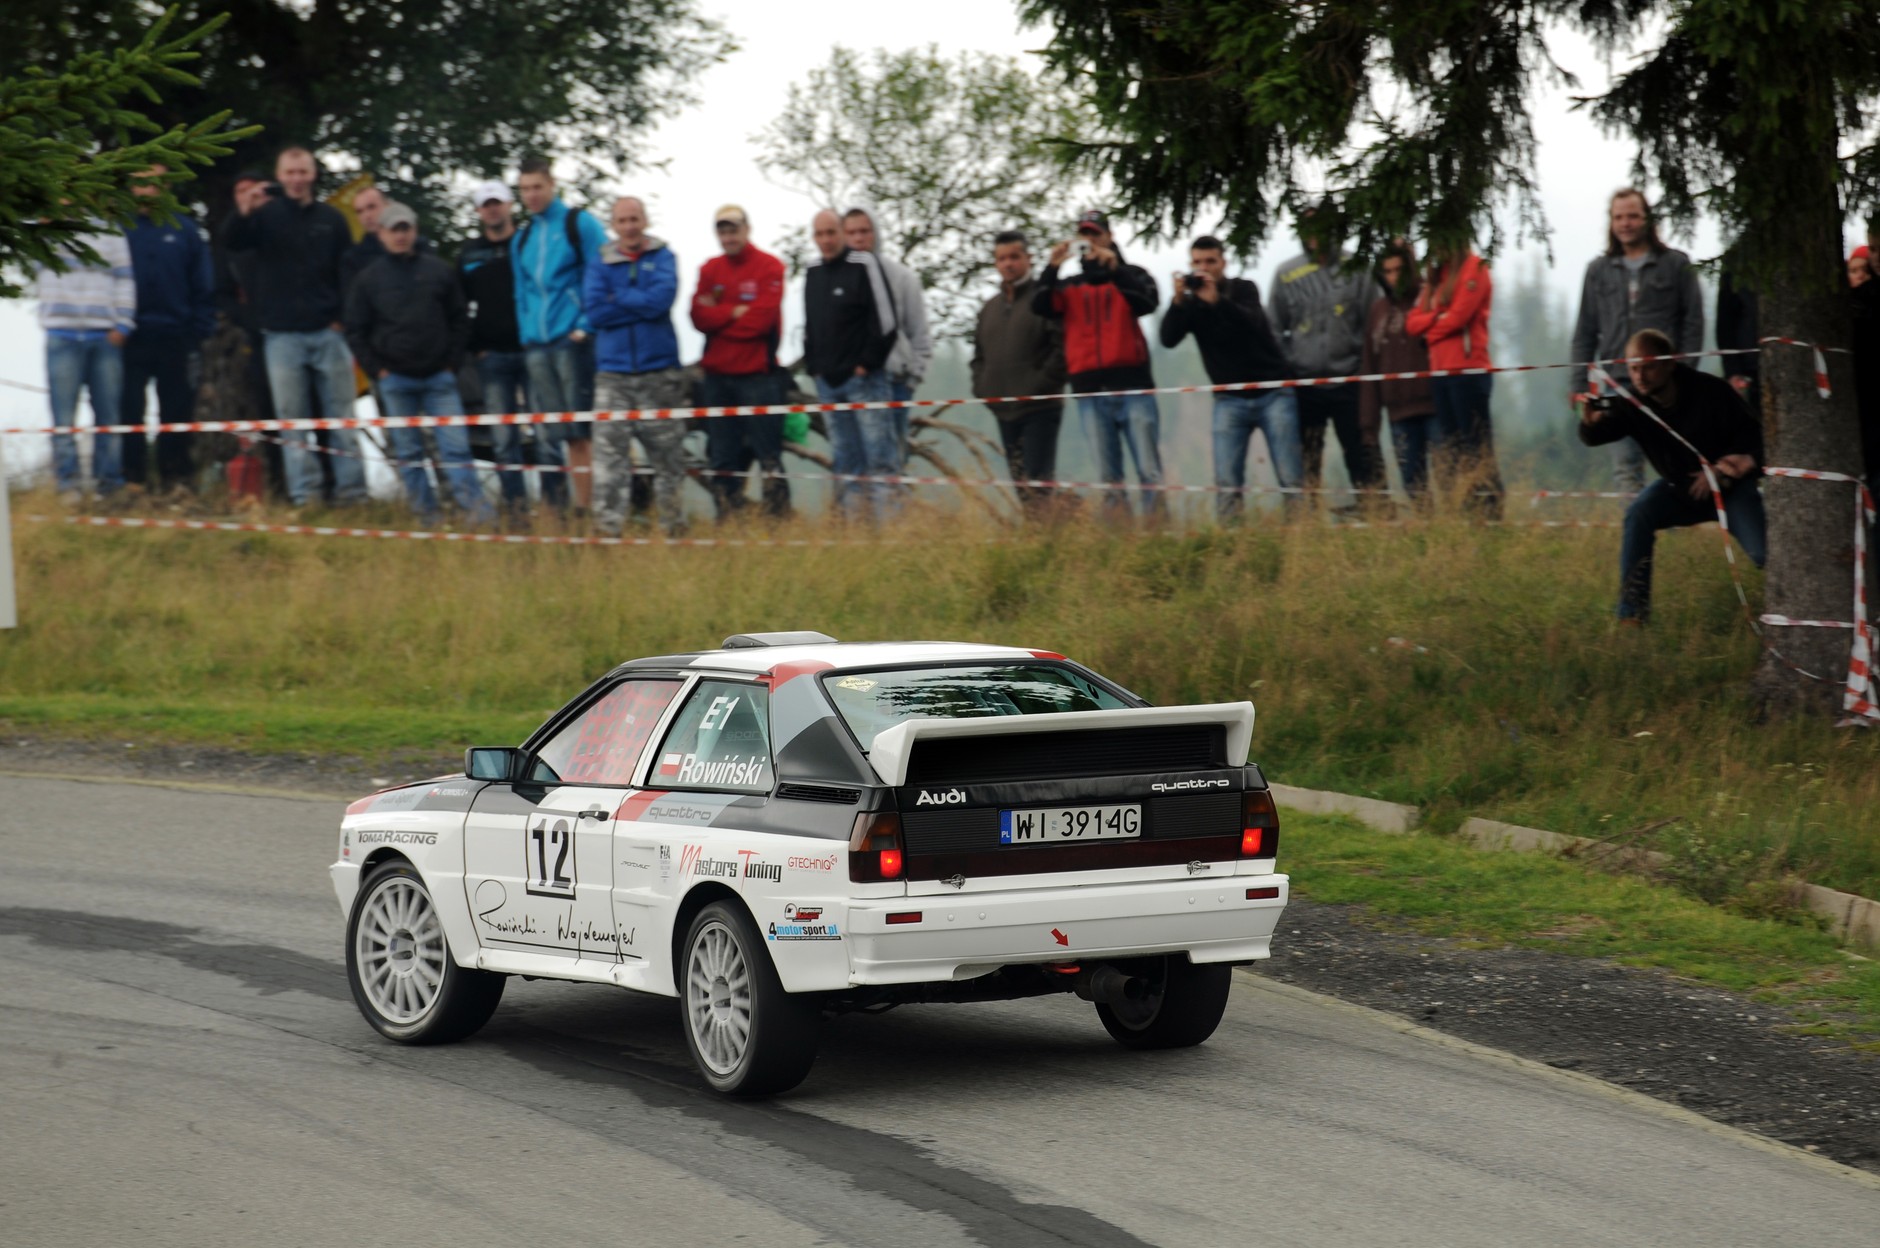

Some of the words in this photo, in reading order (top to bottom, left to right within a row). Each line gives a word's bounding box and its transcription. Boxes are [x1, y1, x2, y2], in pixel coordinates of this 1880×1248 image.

[699, 696, 740, 730] E1
[677, 753, 767, 785] Rowiński
[1151, 779, 1230, 793] quattro
[916, 788, 966, 806] Audi
[649, 806, 712, 821] quattro
[1016, 813, 1046, 839] WI
[1061, 808, 1138, 837] 3914G
[1001, 830, 1010, 839] PL
[531, 818, 572, 890] 12
[659, 845, 671, 860] FIA
[678, 844, 738, 888] Masters
[738, 850, 782, 893] Tuning
[769, 922, 838, 935] 4motorsport.pl
